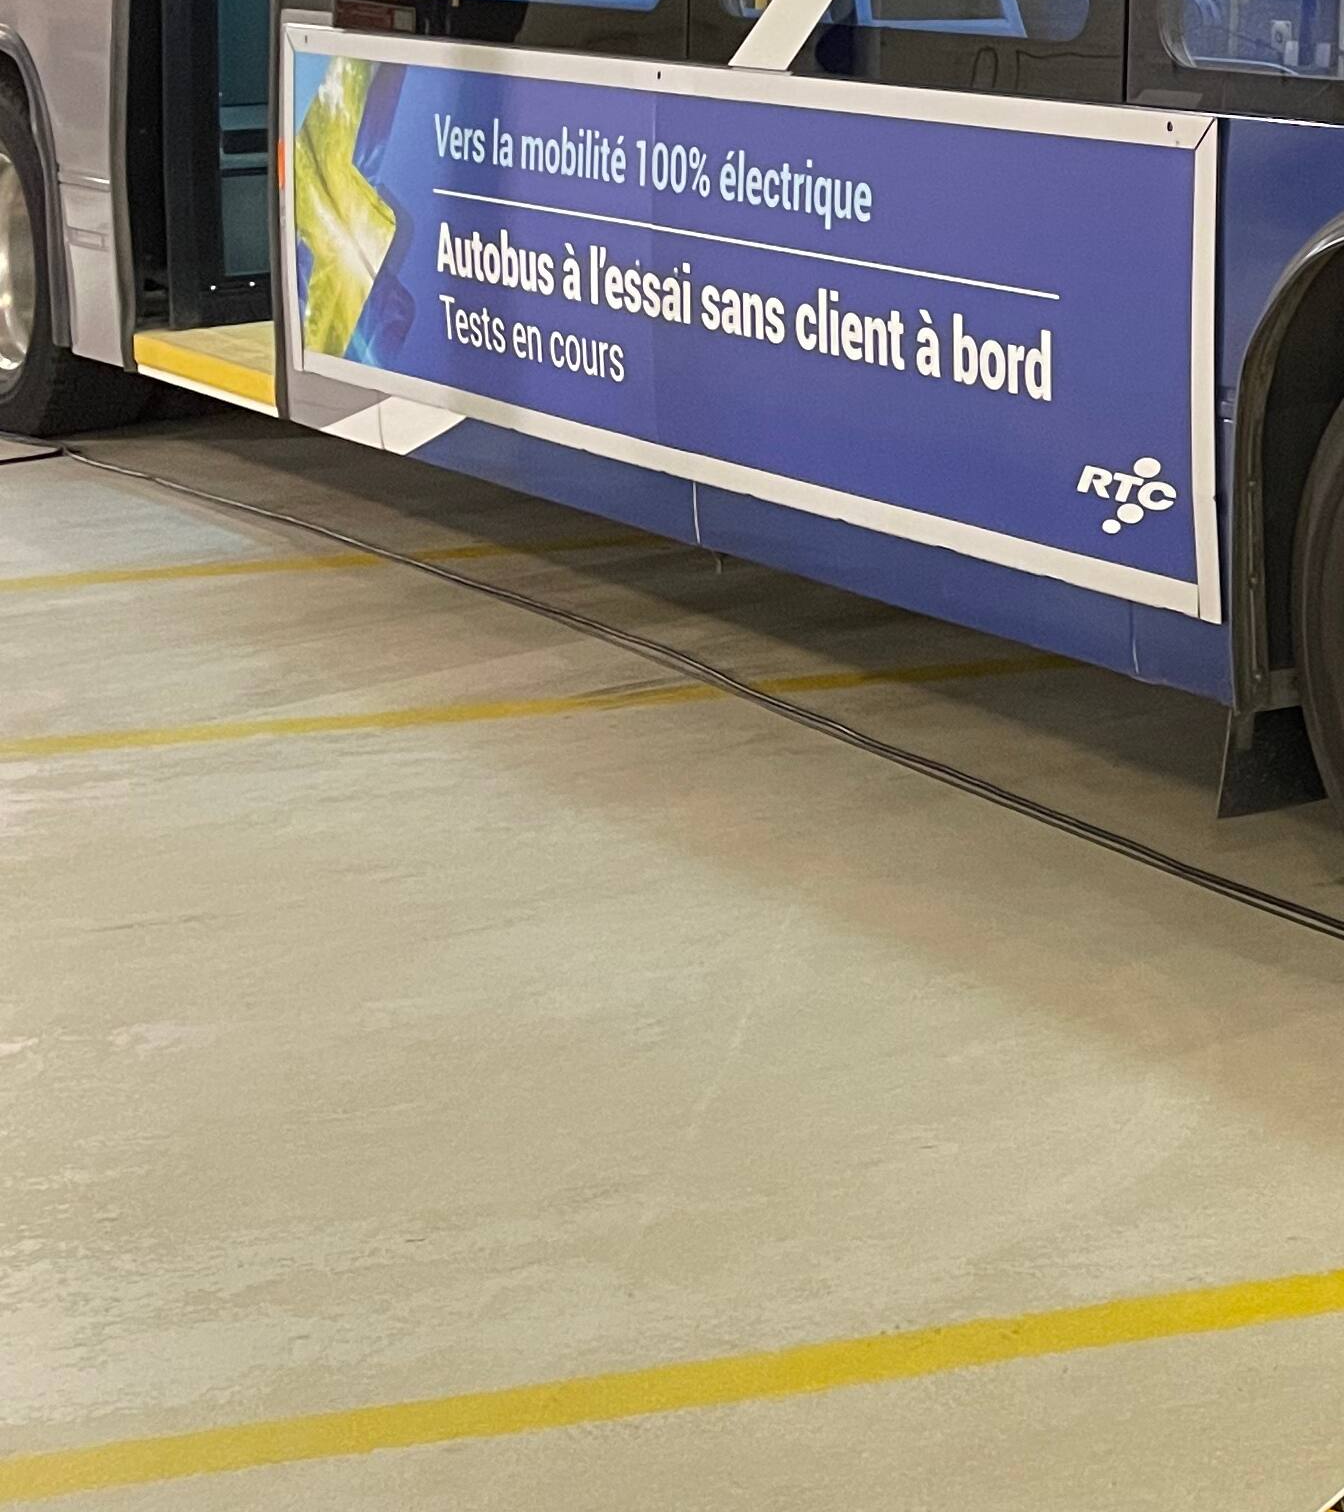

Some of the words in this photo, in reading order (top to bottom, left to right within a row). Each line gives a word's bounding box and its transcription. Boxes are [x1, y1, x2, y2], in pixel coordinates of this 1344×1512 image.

[434, 113, 485, 163] Vers
[491, 118, 513, 168] la
[520, 125, 627, 185] mobilité
[636, 139, 710, 198] 100%
[719, 149, 873, 229] électrique
[436, 221, 554, 296] Autobus
[562, 242, 582, 301] à
[701, 284, 786, 344] sans
[795, 288, 905, 370] client
[915, 306, 942, 378] à
[952, 314, 1053, 401] bord
[439, 294, 506, 354] Tests
[512, 321, 543, 362] en
[550, 329, 626, 383] cours
[1076, 464, 1178, 512] RTC
